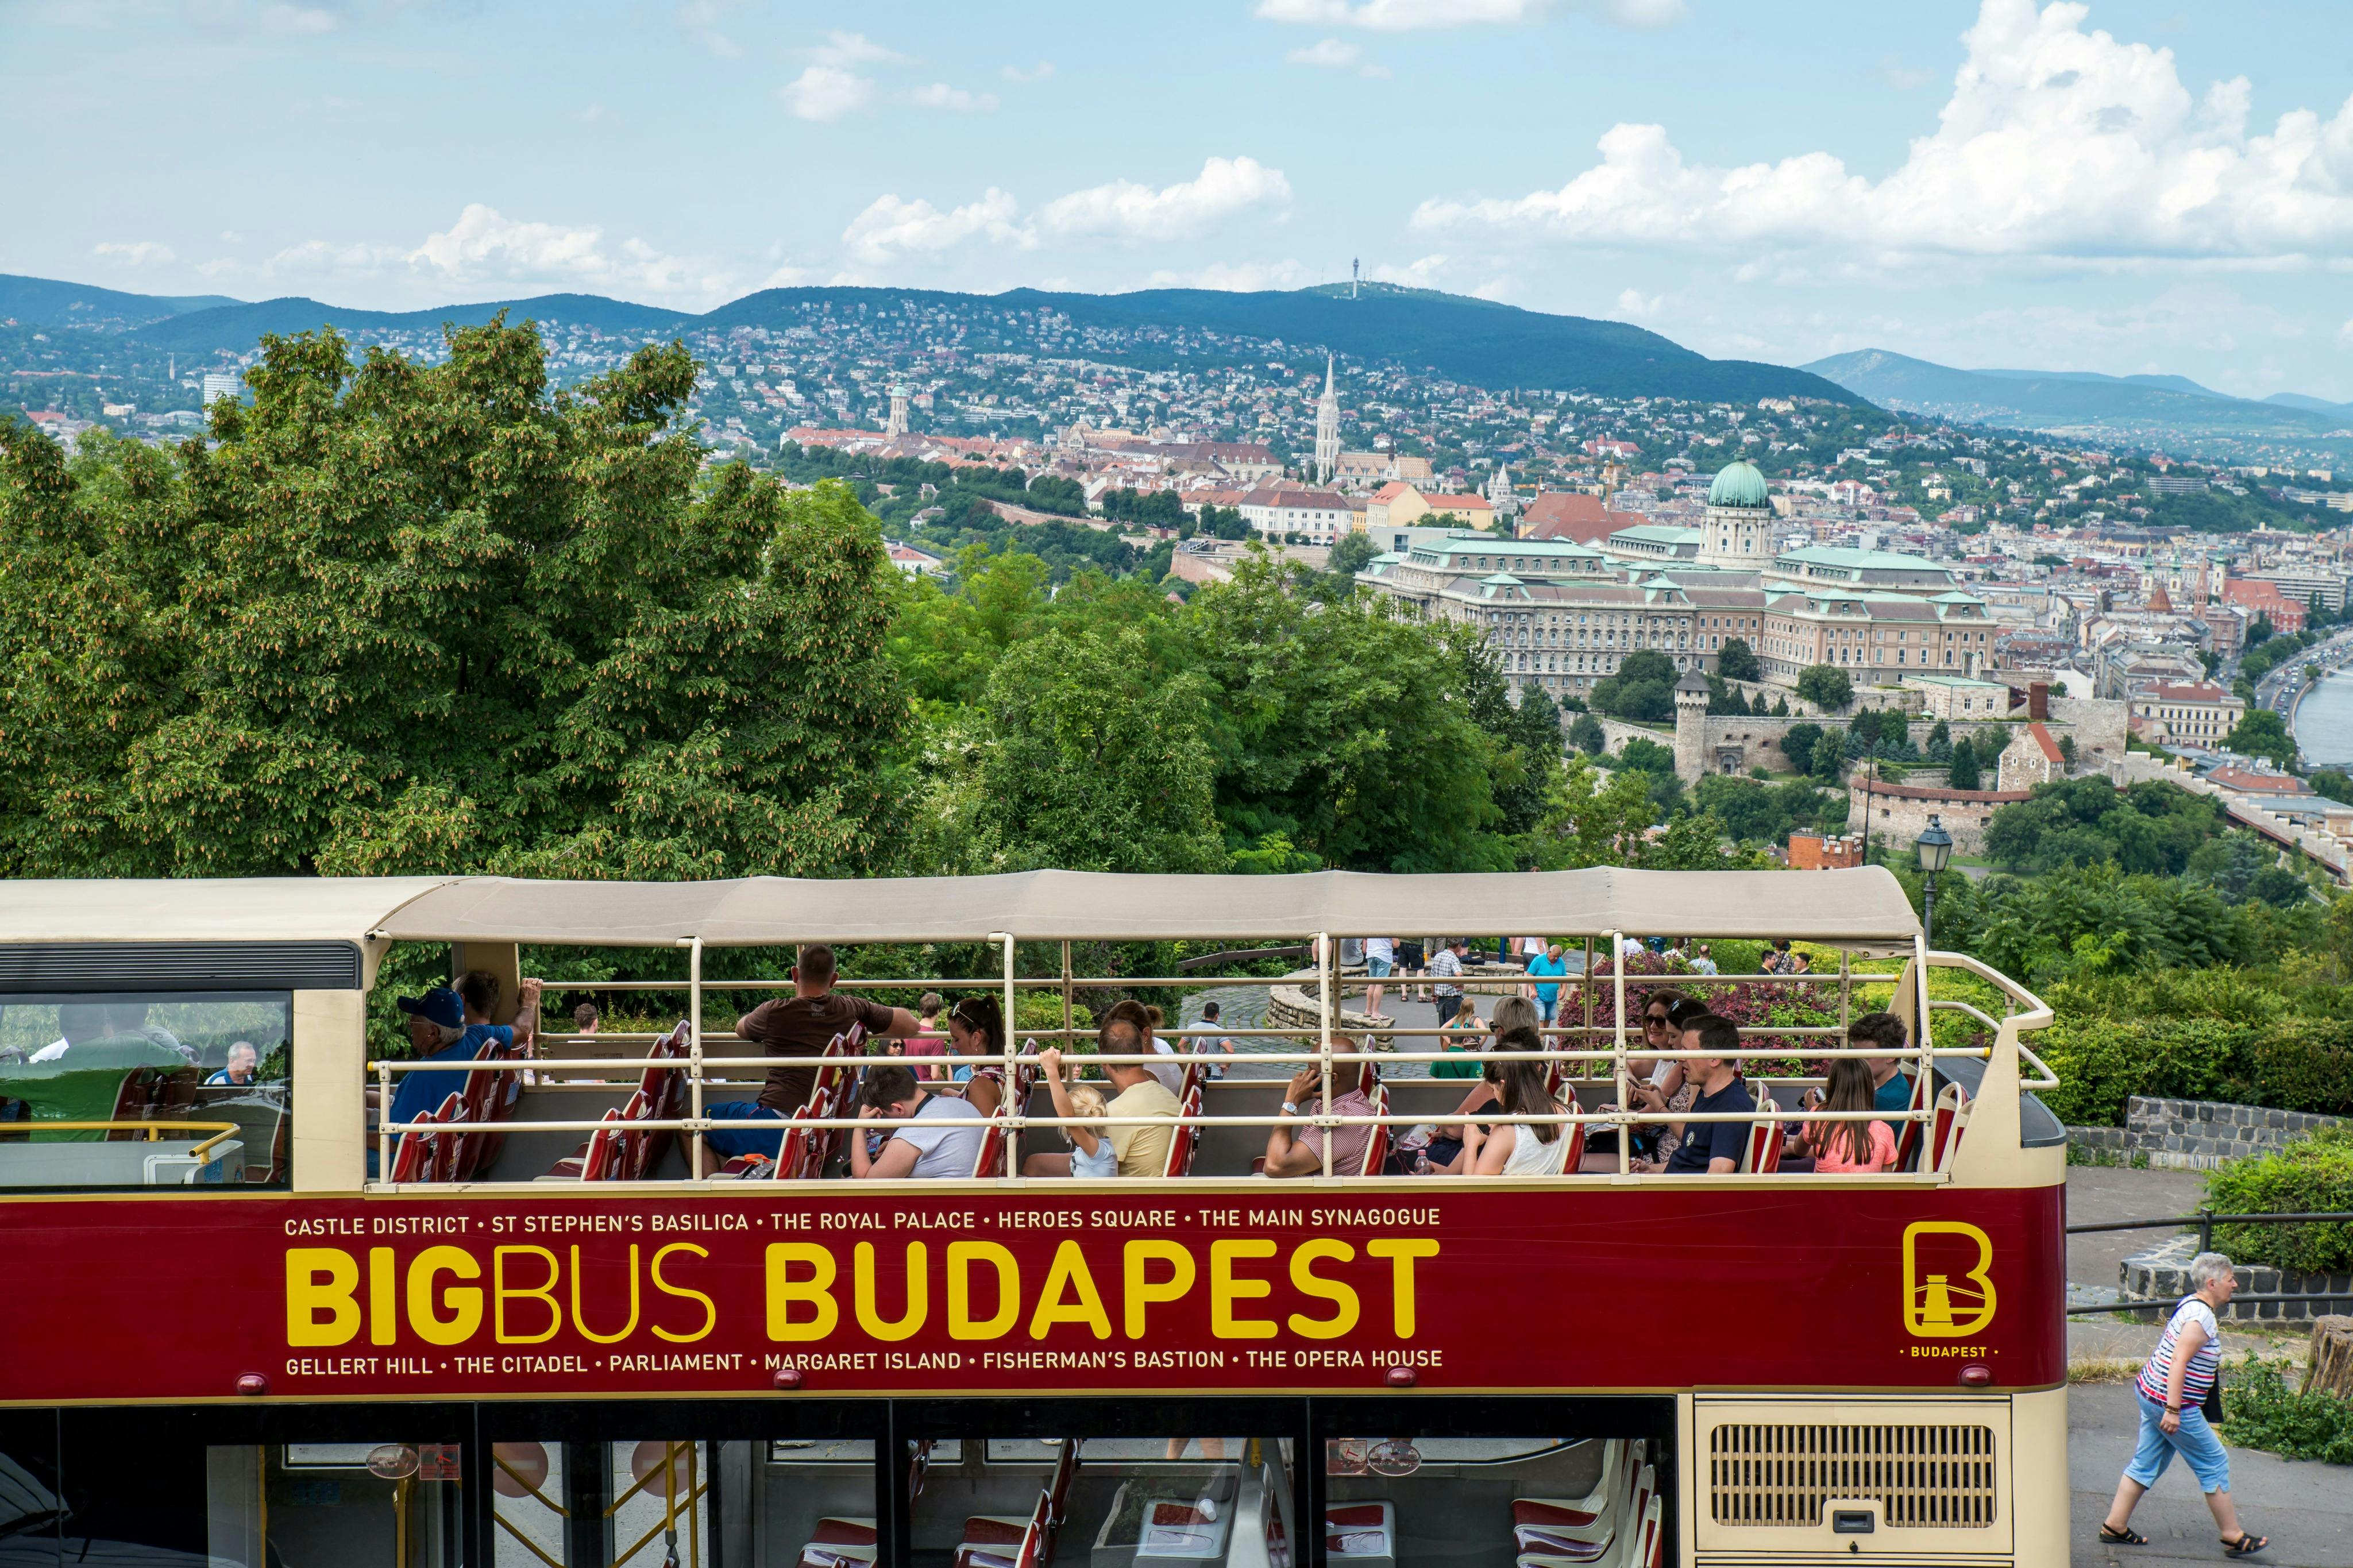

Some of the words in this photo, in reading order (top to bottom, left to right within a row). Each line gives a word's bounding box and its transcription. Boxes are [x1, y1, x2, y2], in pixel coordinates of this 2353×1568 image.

[286, 1218, 364, 1235] CASTLE
[374, 1217, 469, 1234] DISTRICT
[492, 1216, 516, 1232] ST
[525, 1215, 643, 1232] STEPHEN'S
[652, 1214, 748, 1231] BASILICA
[771, 1214, 811, 1229] THE
[821, 1213, 886, 1229] ROYAL
[895, 1212, 974, 1228] PALACE
[1000, 1211, 1082, 1227] HEROES
[1091, 1211, 1175, 1227] SQUARE
[1199, 1210, 1240, 1226] THE
[1249, 1210, 1302, 1226] MAIN
[1311, 1209, 1440, 1225] SYNAGOGUE
[766, 1238, 1440, 1341] BUDAPEST
[287, 1358, 379, 1374] GELLERT
[387, 1358, 433, 1373] HILL
[454, 1357, 494, 1373] THE
[503, 1356, 588, 1373] CITADEL
[611, 1354, 742, 1371] PARLIAMENT
[766, 1353, 877, 1370] MARGARET
[886, 1353, 960, 1369] ISLAND
[984, 1352, 1126, 1368] FISHERMAN'S
[1135, 1351, 1223, 1367] BASTION
[1246, 1351, 1286, 1367] THE
[1295, 1351, 1364, 1366] OPERA
[1373, 1350, 1442, 1367] HOUSE
[1912, 1347, 1986, 1357] BUDAPEST
